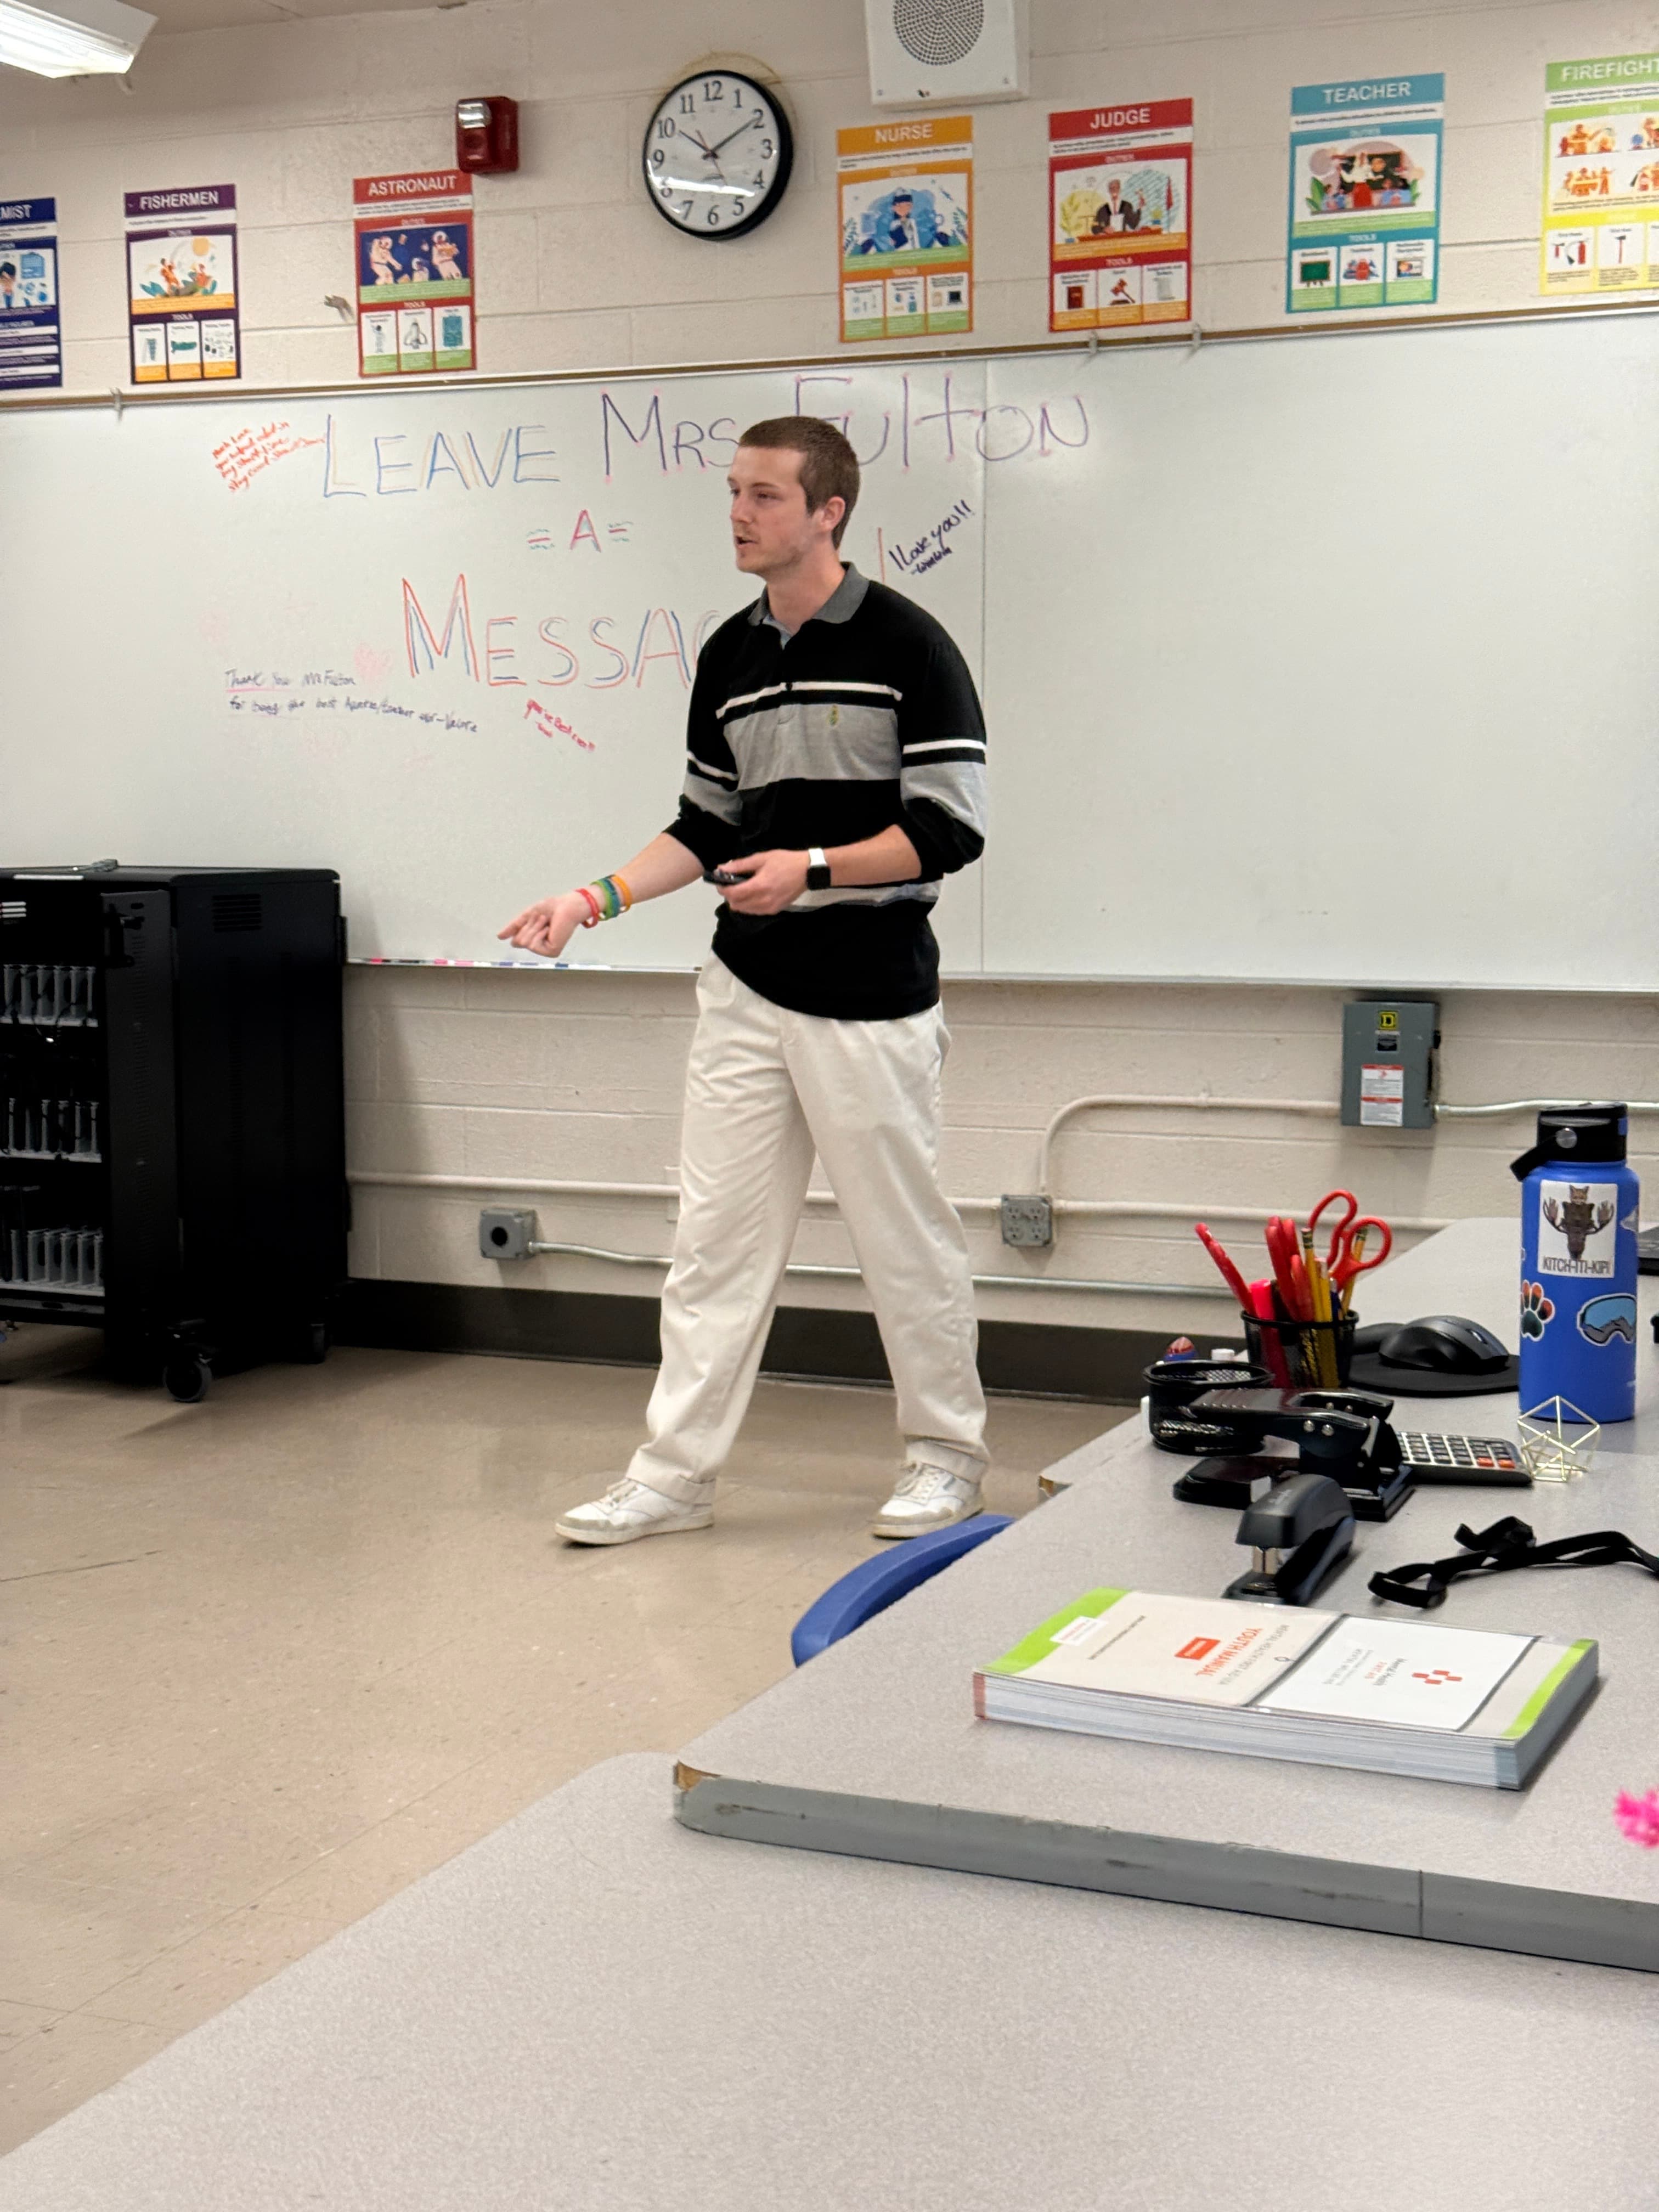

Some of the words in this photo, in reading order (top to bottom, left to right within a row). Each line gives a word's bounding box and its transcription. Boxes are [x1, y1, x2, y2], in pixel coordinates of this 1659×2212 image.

[703, 80, 723, 101] 12
[734, 88, 742, 108] 1
[1323, 81, 1411, 105] TEACHER
[680, 94, 695, 114] 11
[658, 117, 675, 138] 10
[753, 108, 764, 129] 2
[1090, 108, 1151, 130] JUDGE
[874, 122, 934, 144] NURSE
[652, 149, 665, 170] 9
[760, 138, 773, 160] 3
[368, 174, 458, 198] ASTRONAUT
[753, 168, 765, 189] 4
[139, 190, 219, 211] FISHERMEN
[682, 200, 694, 220] 7
[732, 196, 744, 216] 5
[707, 205, 720, 225] 6
[324, 414, 561, 497] LEAVE
[569, 509, 601, 552] A
[1382, 1014, 1395, 1026] D
[1227, 1628, 1263, 1651] YOUTH
[1195, 1650, 1240, 1677] MANUAL
